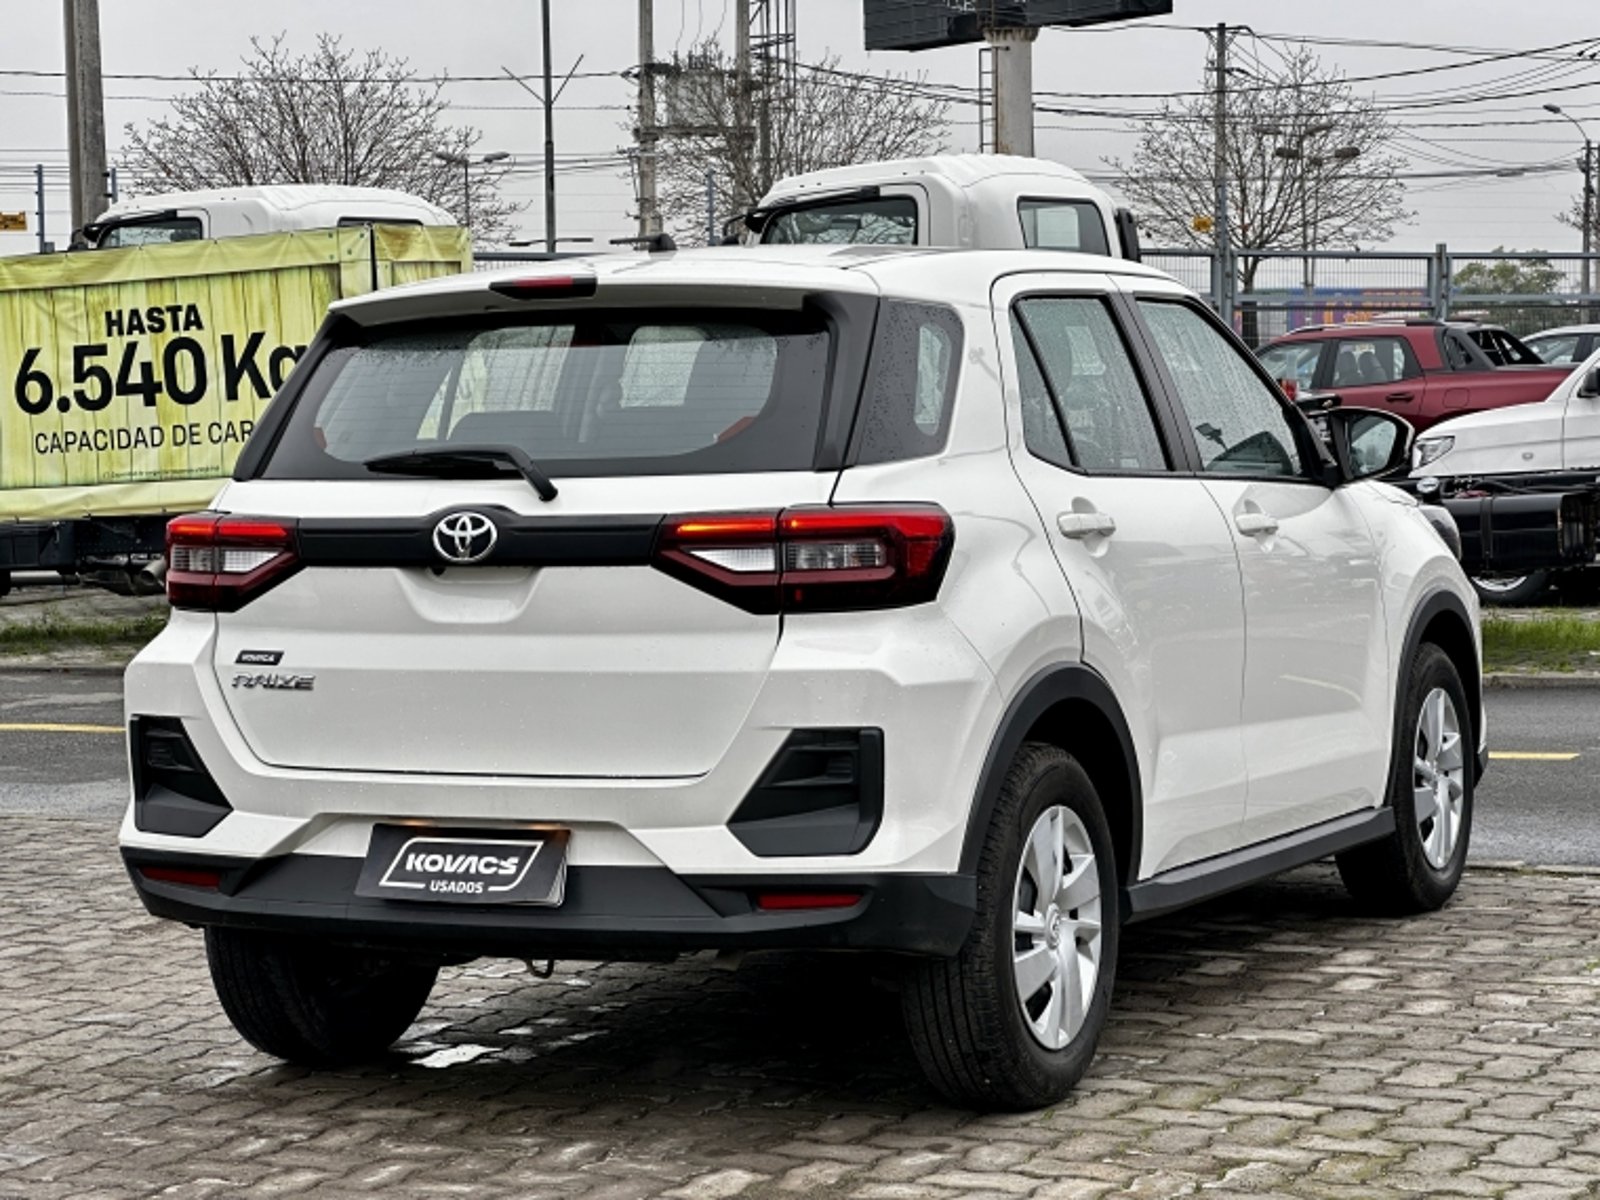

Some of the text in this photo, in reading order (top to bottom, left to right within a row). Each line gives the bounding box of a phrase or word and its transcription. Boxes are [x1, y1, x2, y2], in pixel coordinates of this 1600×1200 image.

[105, 303, 204, 337] HASTA
[15, 336, 207, 415] 6.540
[35, 425, 165, 454] CAPACIDAD
[173, 422, 201, 447] DE
[405, 853, 519, 875] KOVACS
[429, 878, 484, 894] USADOS
